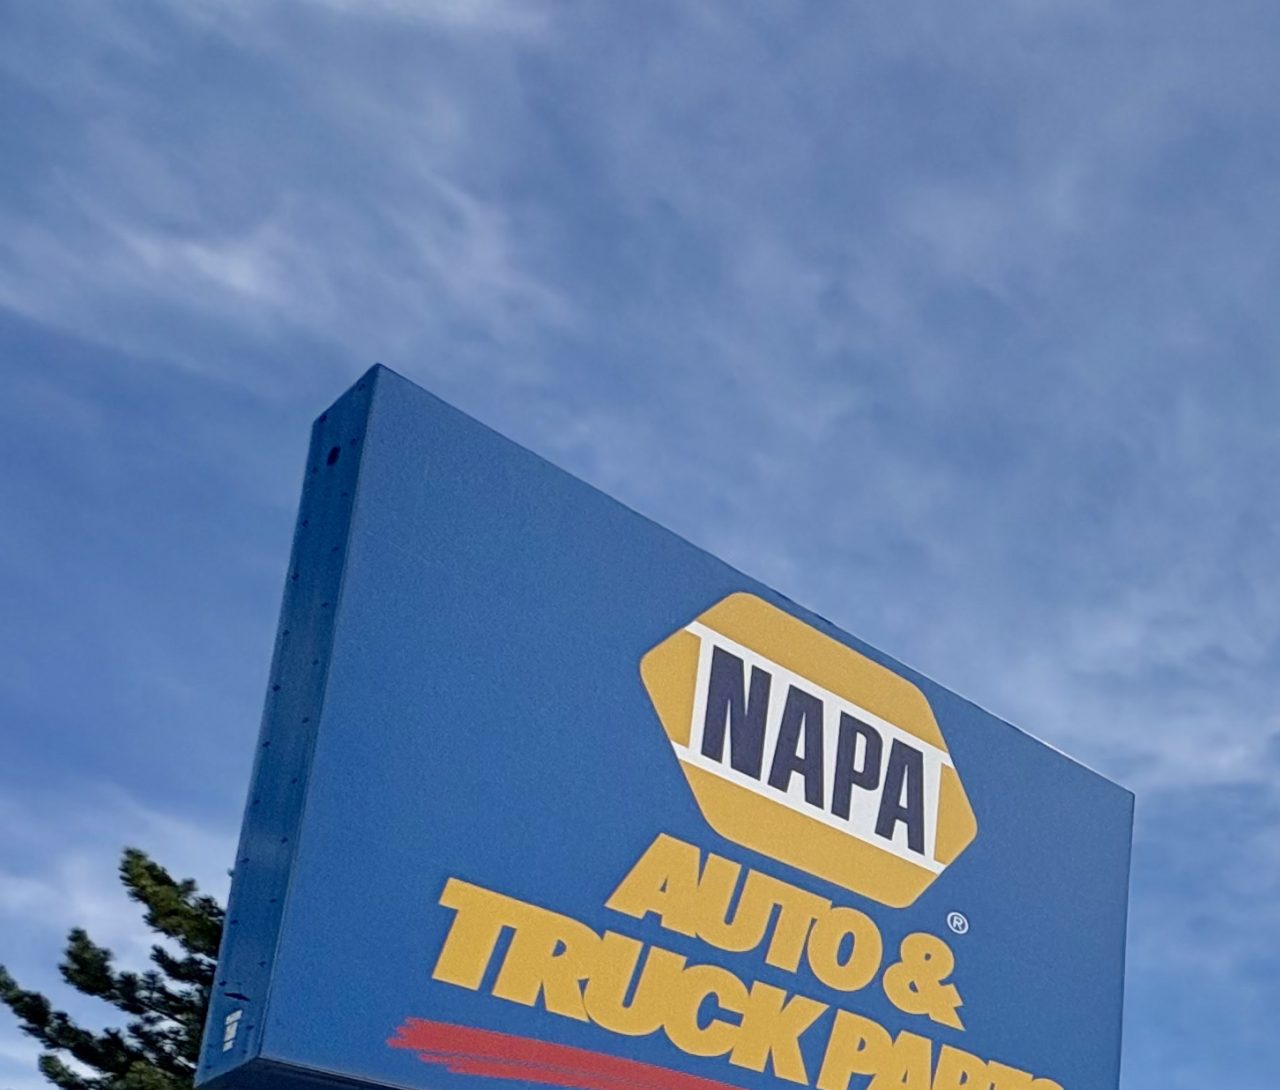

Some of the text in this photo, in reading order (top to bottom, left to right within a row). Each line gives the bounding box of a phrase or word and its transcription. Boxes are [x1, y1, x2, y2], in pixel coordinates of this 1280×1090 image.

[701, 645, 925, 855] NAPA
[432, 878, 826, 1083] TRUCK
[605, 833, 966, 1031] AUTO &
